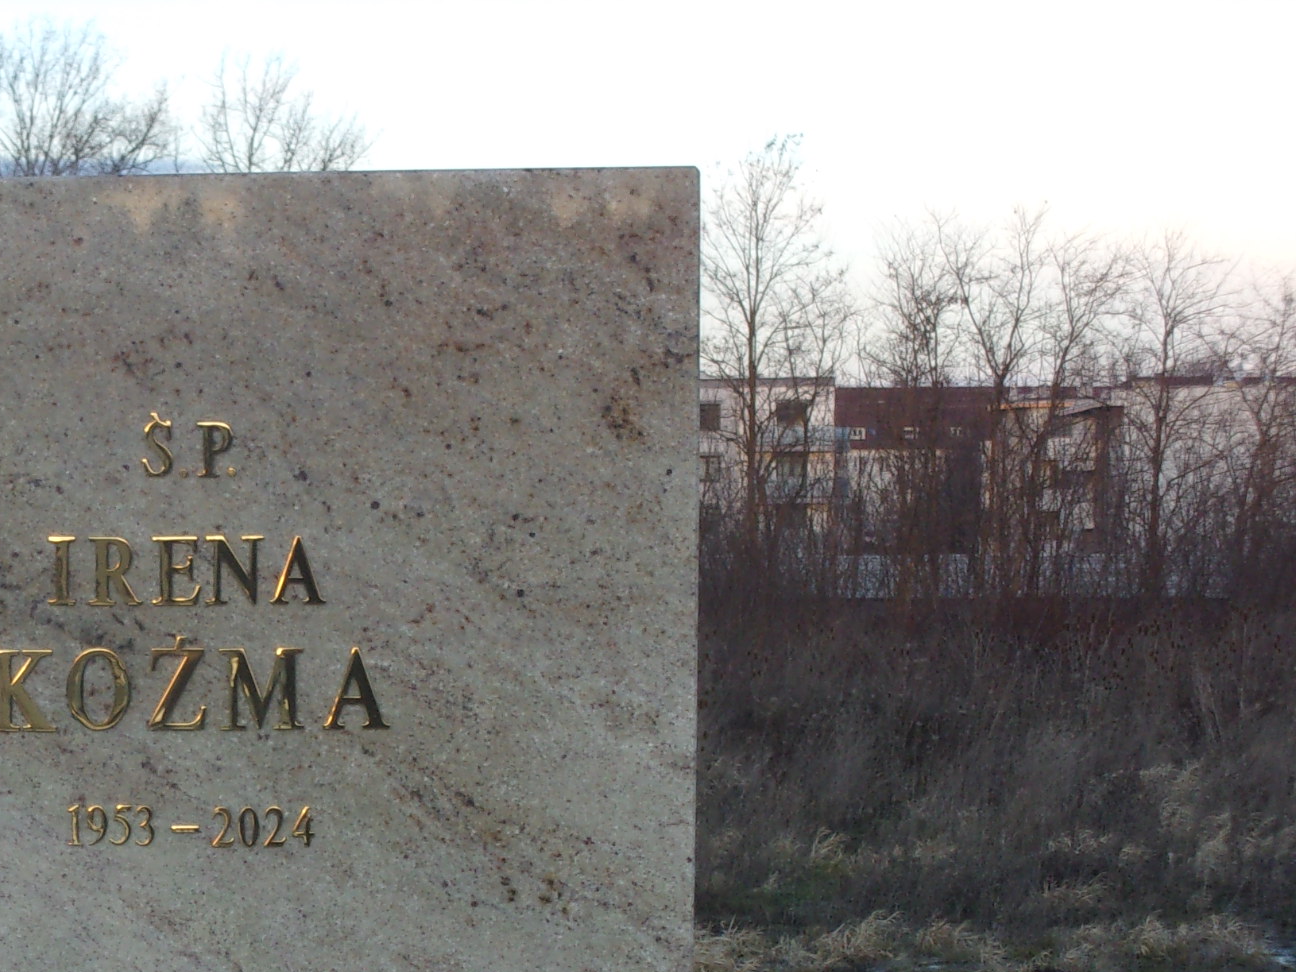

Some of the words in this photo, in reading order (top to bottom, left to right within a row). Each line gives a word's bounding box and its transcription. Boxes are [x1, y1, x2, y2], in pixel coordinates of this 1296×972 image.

[46, 533, 327, 607] IRENA
[67, 803, 155, 847] 1953
[211, 805, 316, 848] 2024
